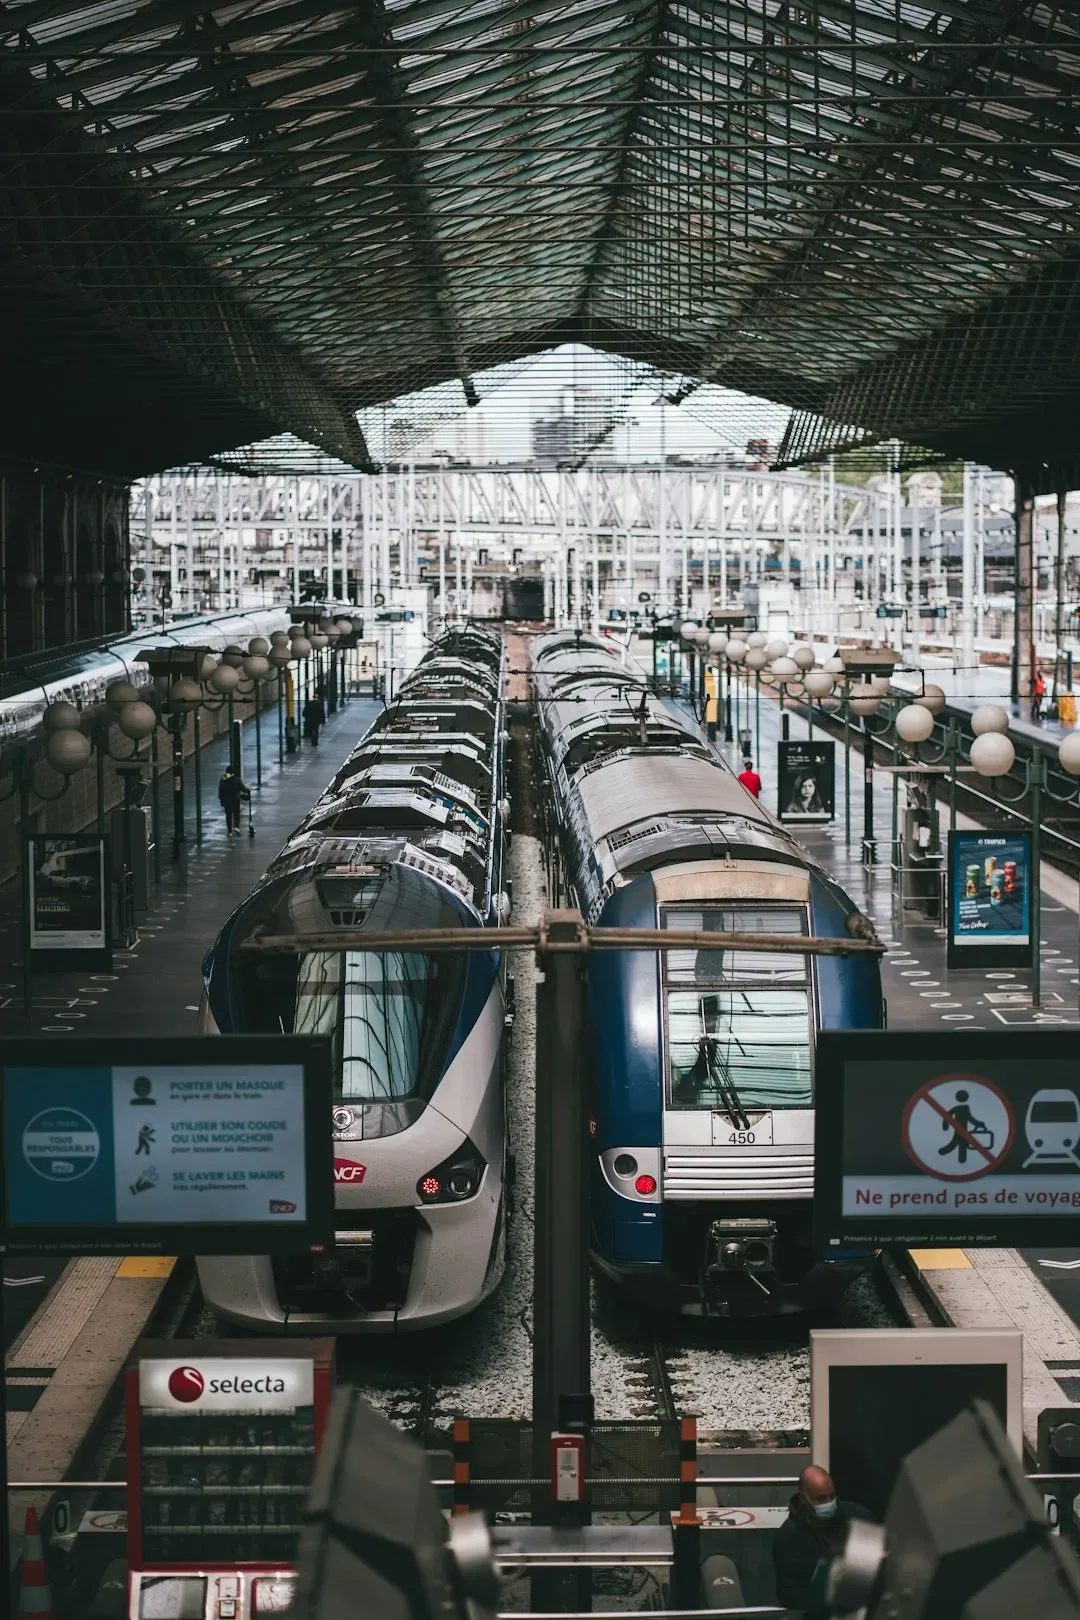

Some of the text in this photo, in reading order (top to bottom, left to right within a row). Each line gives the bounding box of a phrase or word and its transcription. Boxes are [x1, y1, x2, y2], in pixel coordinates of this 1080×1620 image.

[170, 1080, 285, 1091] PORTER UN MASQUE
[171, 1120, 287, 1131] UTILISER SON COUDE
[171, 1132, 274, 1143] OU UN MOUCHOIR
[728, 1132, 755, 1144] 450
[26, 1144, 96, 1152] RESPONSABLES
[172, 1170, 285, 1181] SE LAVER LES MAINS
[334, 1167, 363, 1180] NCF
[856, 1188, 1080, 1207] Ne prend pas de voyag
[209, 1376, 284, 1394] selecta
